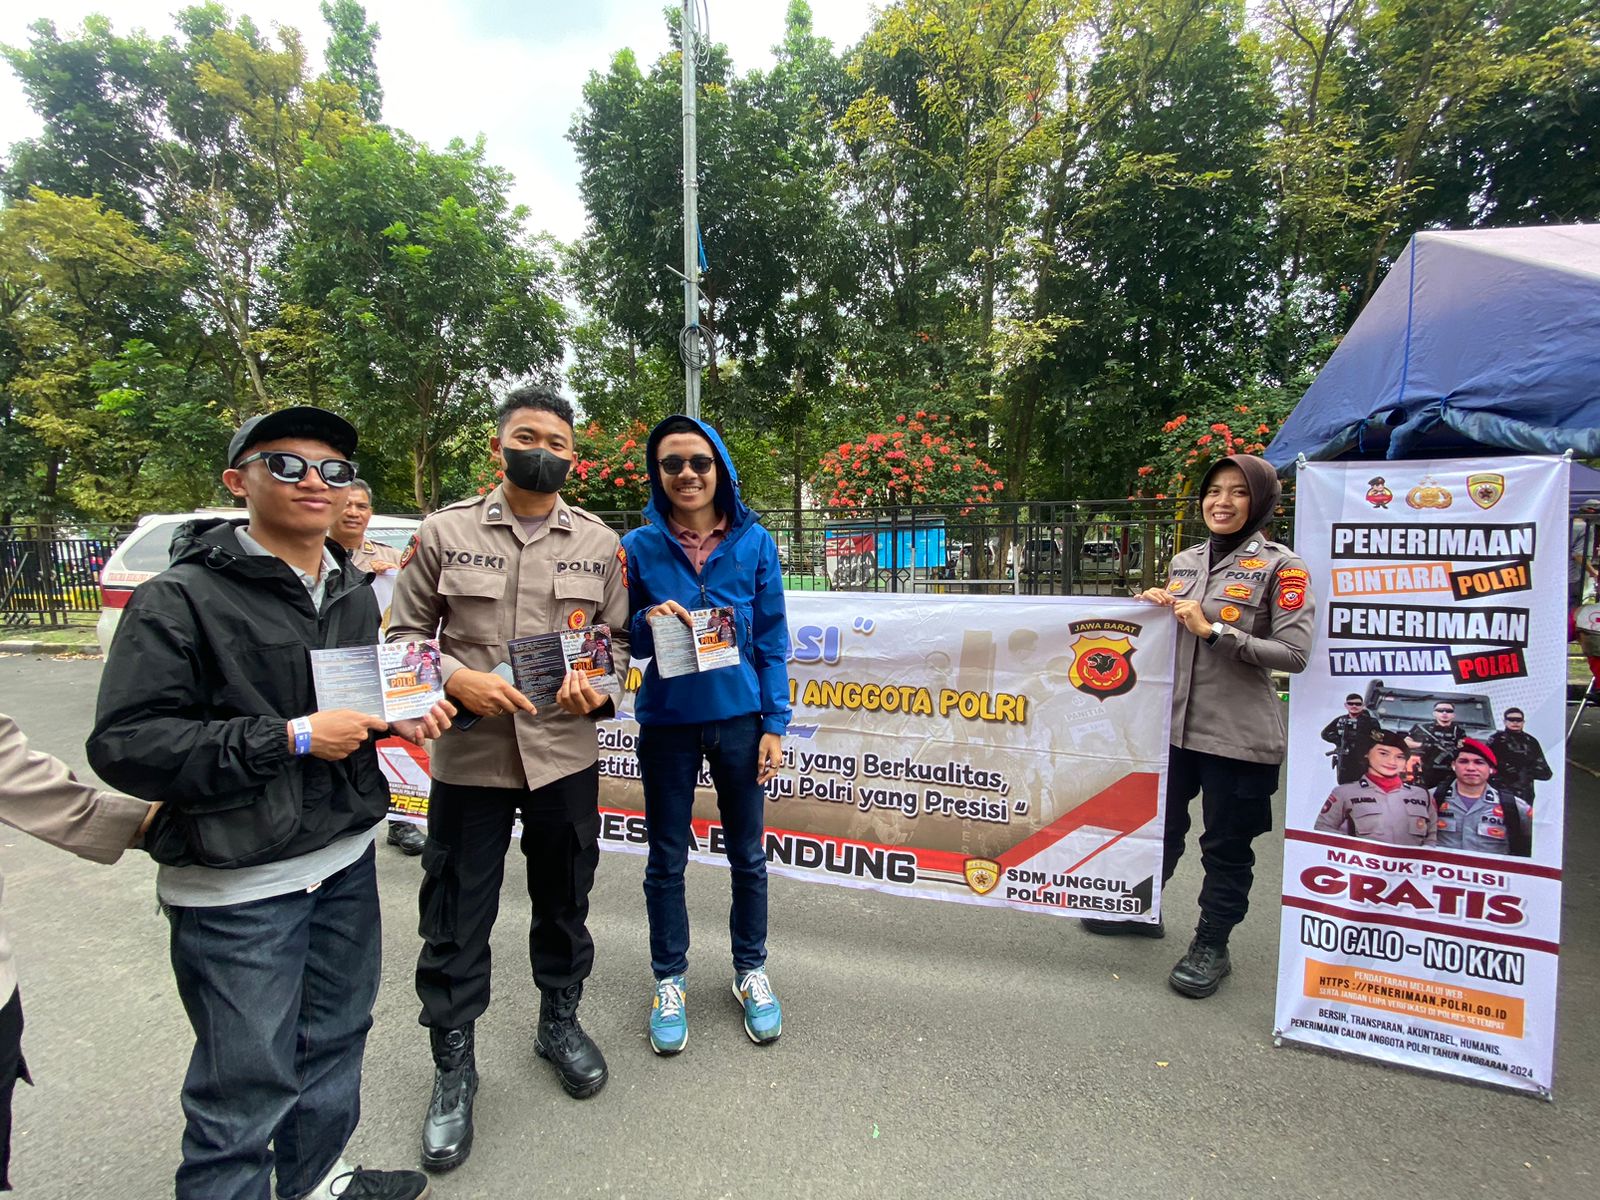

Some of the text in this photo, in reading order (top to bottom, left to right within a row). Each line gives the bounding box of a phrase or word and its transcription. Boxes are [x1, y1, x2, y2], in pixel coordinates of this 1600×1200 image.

[1335, 528, 1533, 555] PENERIMAAN
[444, 550, 505, 569] YOEKI
[557, 561, 606, 575] POLRI
[1225, 571, 1267, 581] POLRI
[1336, 565, 1527, 596] BINTARA POLRI
[1074, 622, 1137, 633] JAWA BARAT
[1332, 608, 1526, 641] PENERIMAAN
[1330, 650, 1520, 680] TAMTAMA POLRI
[391, 677, 417, 688] POLRI
[803, 679, 933, 715] ANGGOTA
[939, 688, 1026, 723] POLRI
[800, 751, 856, 776] yang
[864, 754, 1009, 792] Berkualitas,
[799, 777, 852, 800] Polri
[859, 787, 918, 815] yang
[925, 790, 1008, 820] Presisi
[1007, 868, 1132, 894] SDM UNGGUL
[1327, 850, 1504, 888] MASUK POLISI
[1006, 887, 1140, 913] POLRI PRESISI
[1300, 865, 1524, 925] GRATIS
[1301, 915, 1338, 950] NO
[1342, 926, 1404, 962] CALO
[1424, 938, 1463, 973] NO
[1466, 945, 1525, 985] KKN
[1354, 970, 1408, 989] PENDAFTARAN
[1409, 981, 1444, 996] MELALUI
[1319, 988, 1339, 998] SERTA
[1341, 991, 1367, 1003] JANGAN
[1368, 995, 1386, 1006] LUPA
[1388, 999, 1426, 1014] VERIFIKASI
[1427, 1008, 1436, 1016] DI
[1467, 1015, 1505, 1030] SETEMPAT
[1319, 1008, 1502, 1056] BERSIH, TRANSPARAN, AKUNTABEL, HUMANIS.
[1290, 1018, 1533, 1078] PENERIMAAN CALON ANGGOTA POLRI TAHUN ANGGARAN 2024
